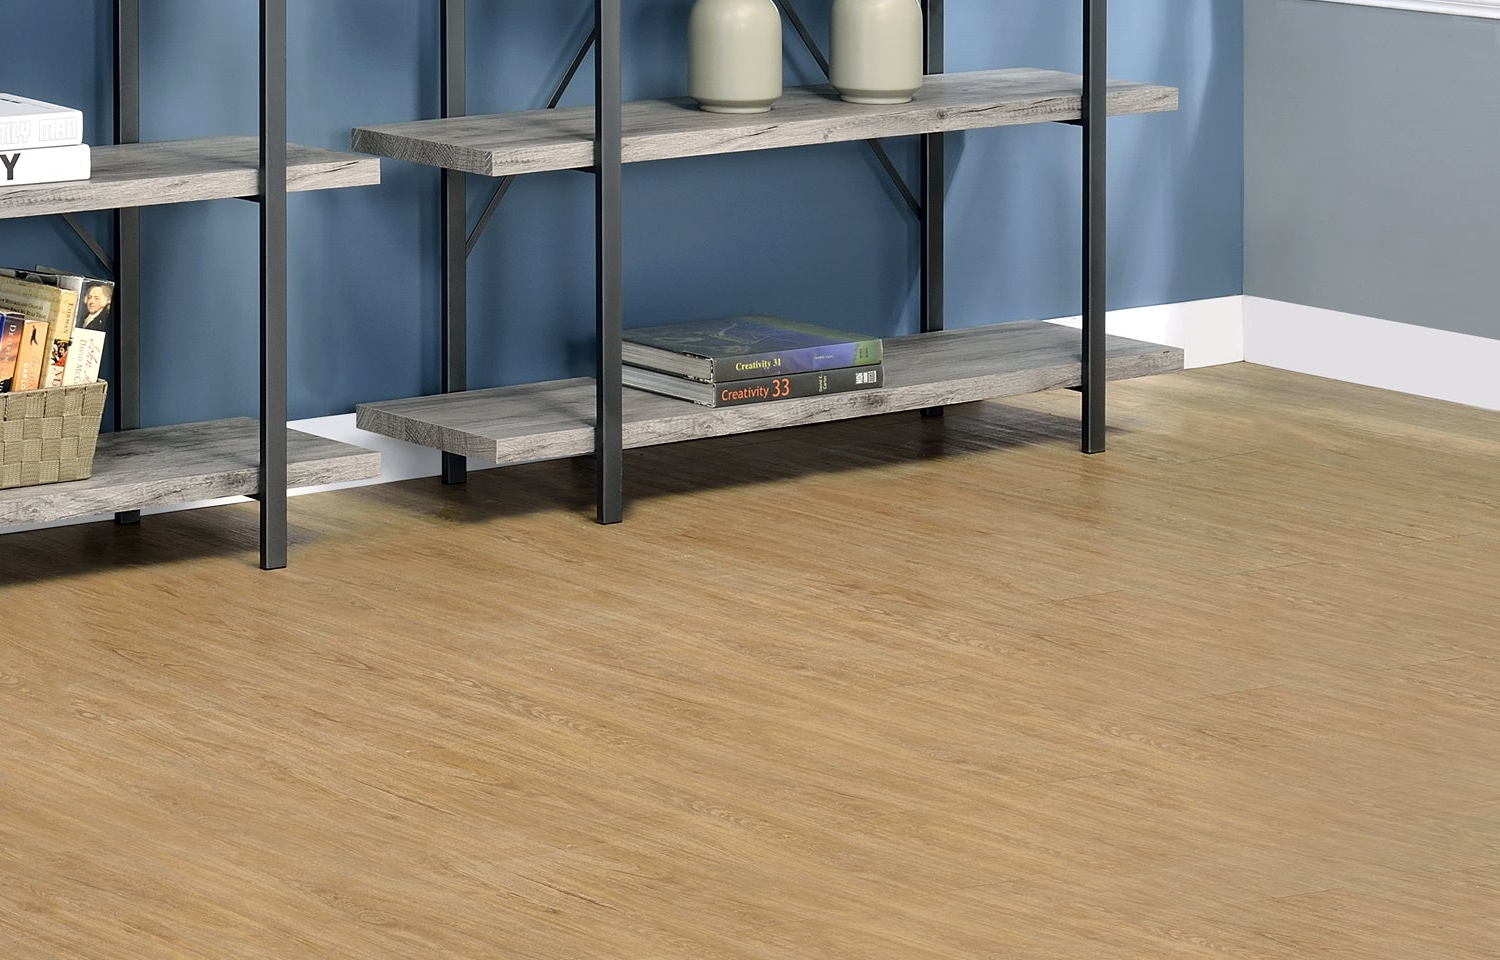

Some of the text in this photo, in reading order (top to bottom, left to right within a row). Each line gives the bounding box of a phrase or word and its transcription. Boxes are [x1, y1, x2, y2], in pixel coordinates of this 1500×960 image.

[735, 358, 781, 371] Creativity 31
[721, 378, 791, 401] Creativity 33
